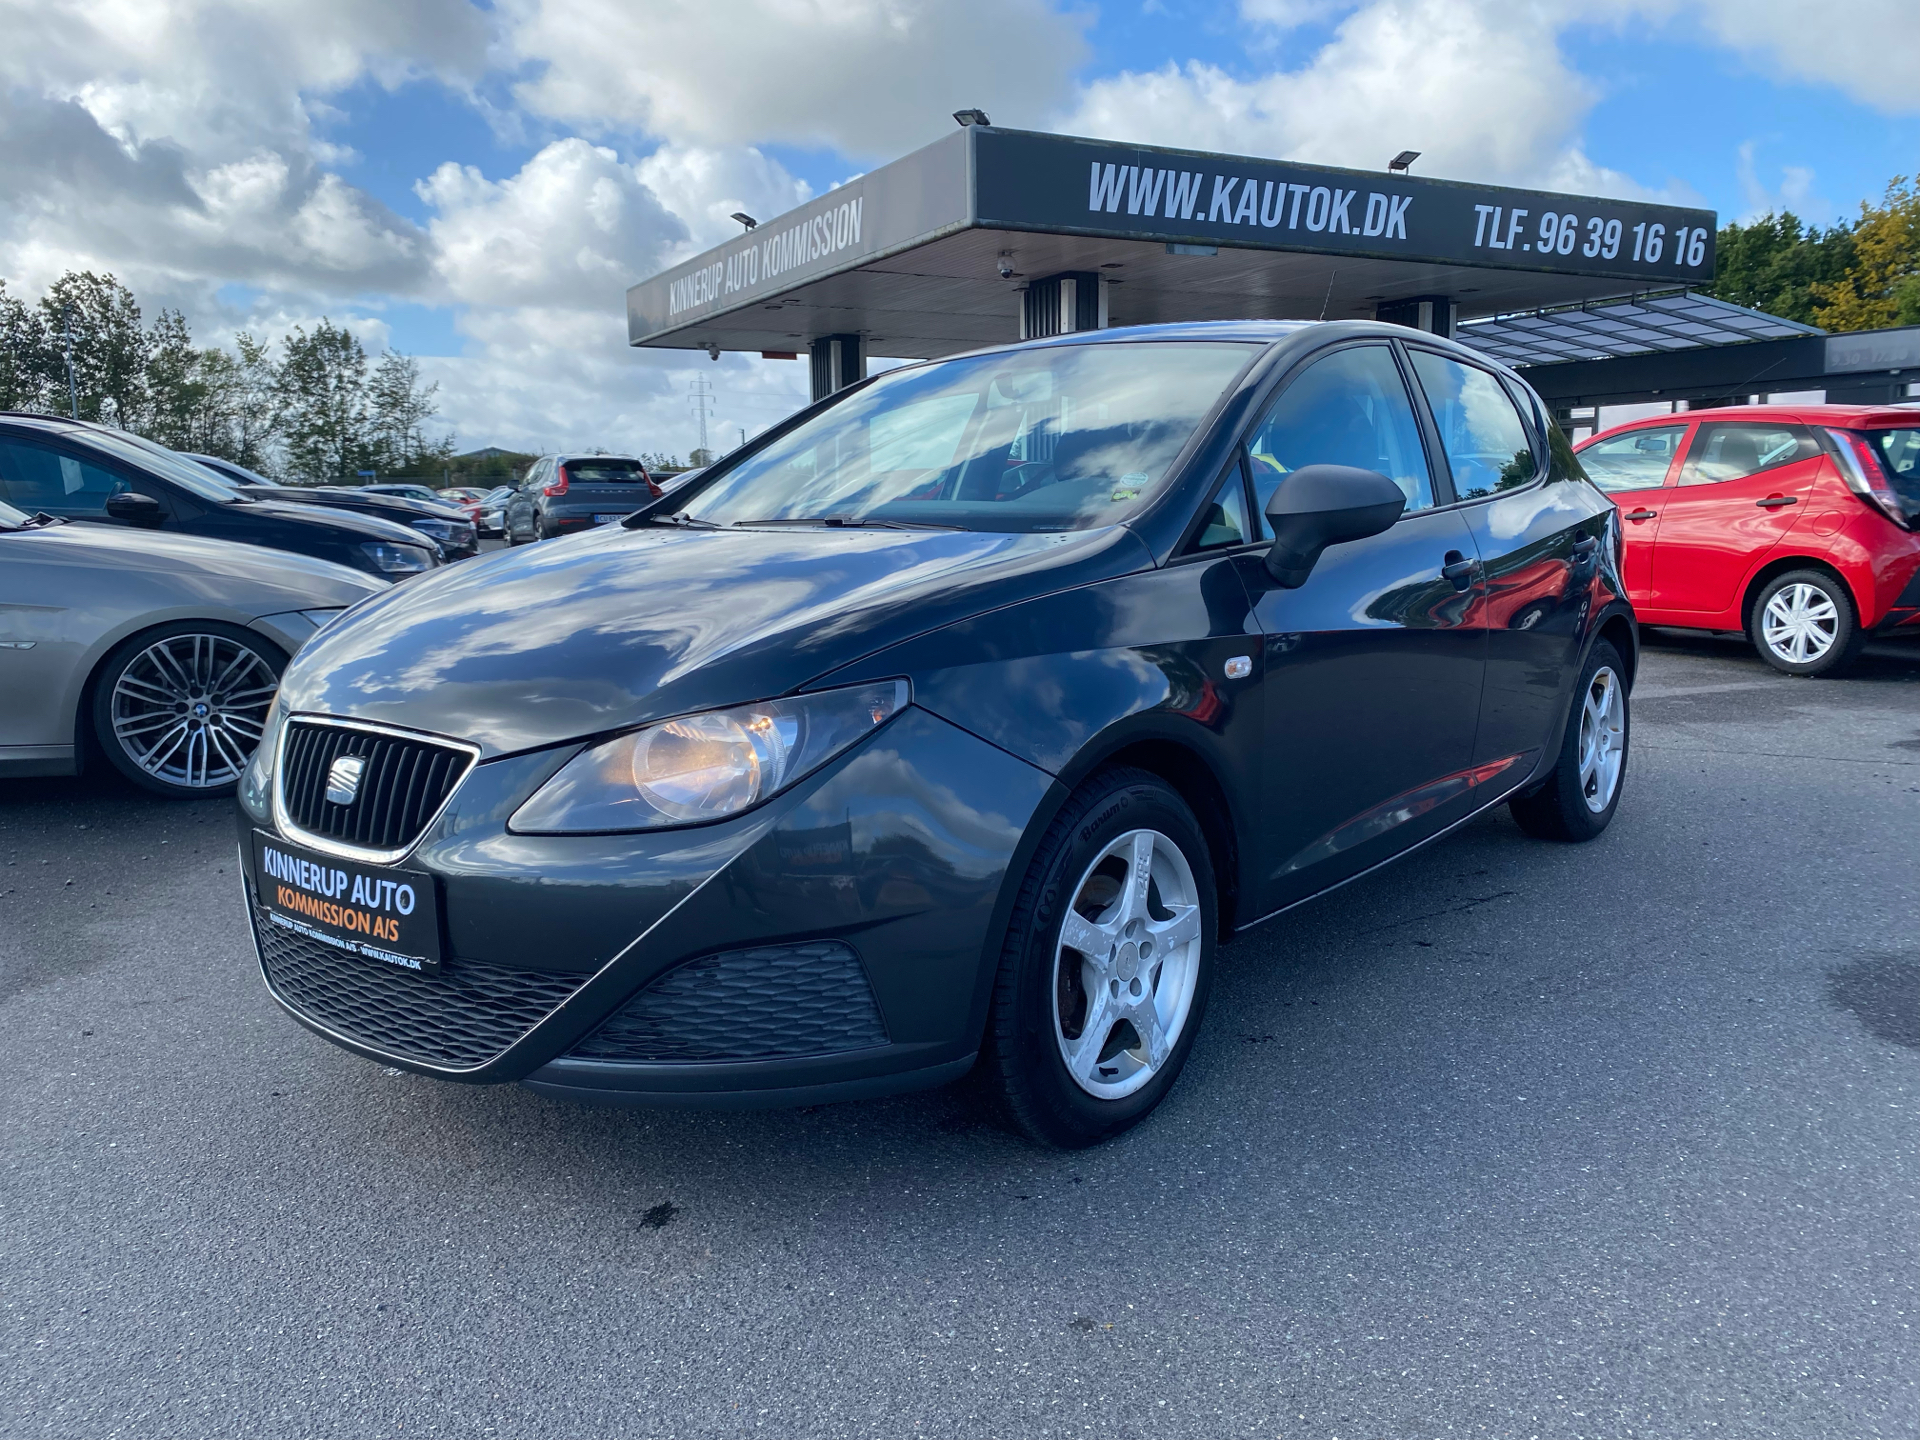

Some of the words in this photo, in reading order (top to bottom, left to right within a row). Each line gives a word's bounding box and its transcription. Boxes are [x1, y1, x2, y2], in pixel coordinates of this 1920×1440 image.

[1088, 161, 1413, 239] WWW.KAUTOK.DK
[669, 261, 724, 316] KINNERUP
[725, 245, 759, 295] AUTO
[761, 196, 864, 281] KOMMISSION
[1474, 204, 1530, 251] TLF.
[1537, 211, 1578, 256] 96
[1583, 216, 1623, 260] 39
[1632, 222, 1666, 263] 16
[1675, 226, 1708, 267] 16
[1078, 803, 1120, 843] Barum
[264, 846, 348, 900] KINNERUP
[351, 874, 415, 916] AUTO
[277, 885, 370, 935] KOMMISSION
[373, 919, 399, 942] A/S
[309, 929, 345, 951] KOMMISSION
[360, 946, 422, 970] WWW.KAUTOK.DK
